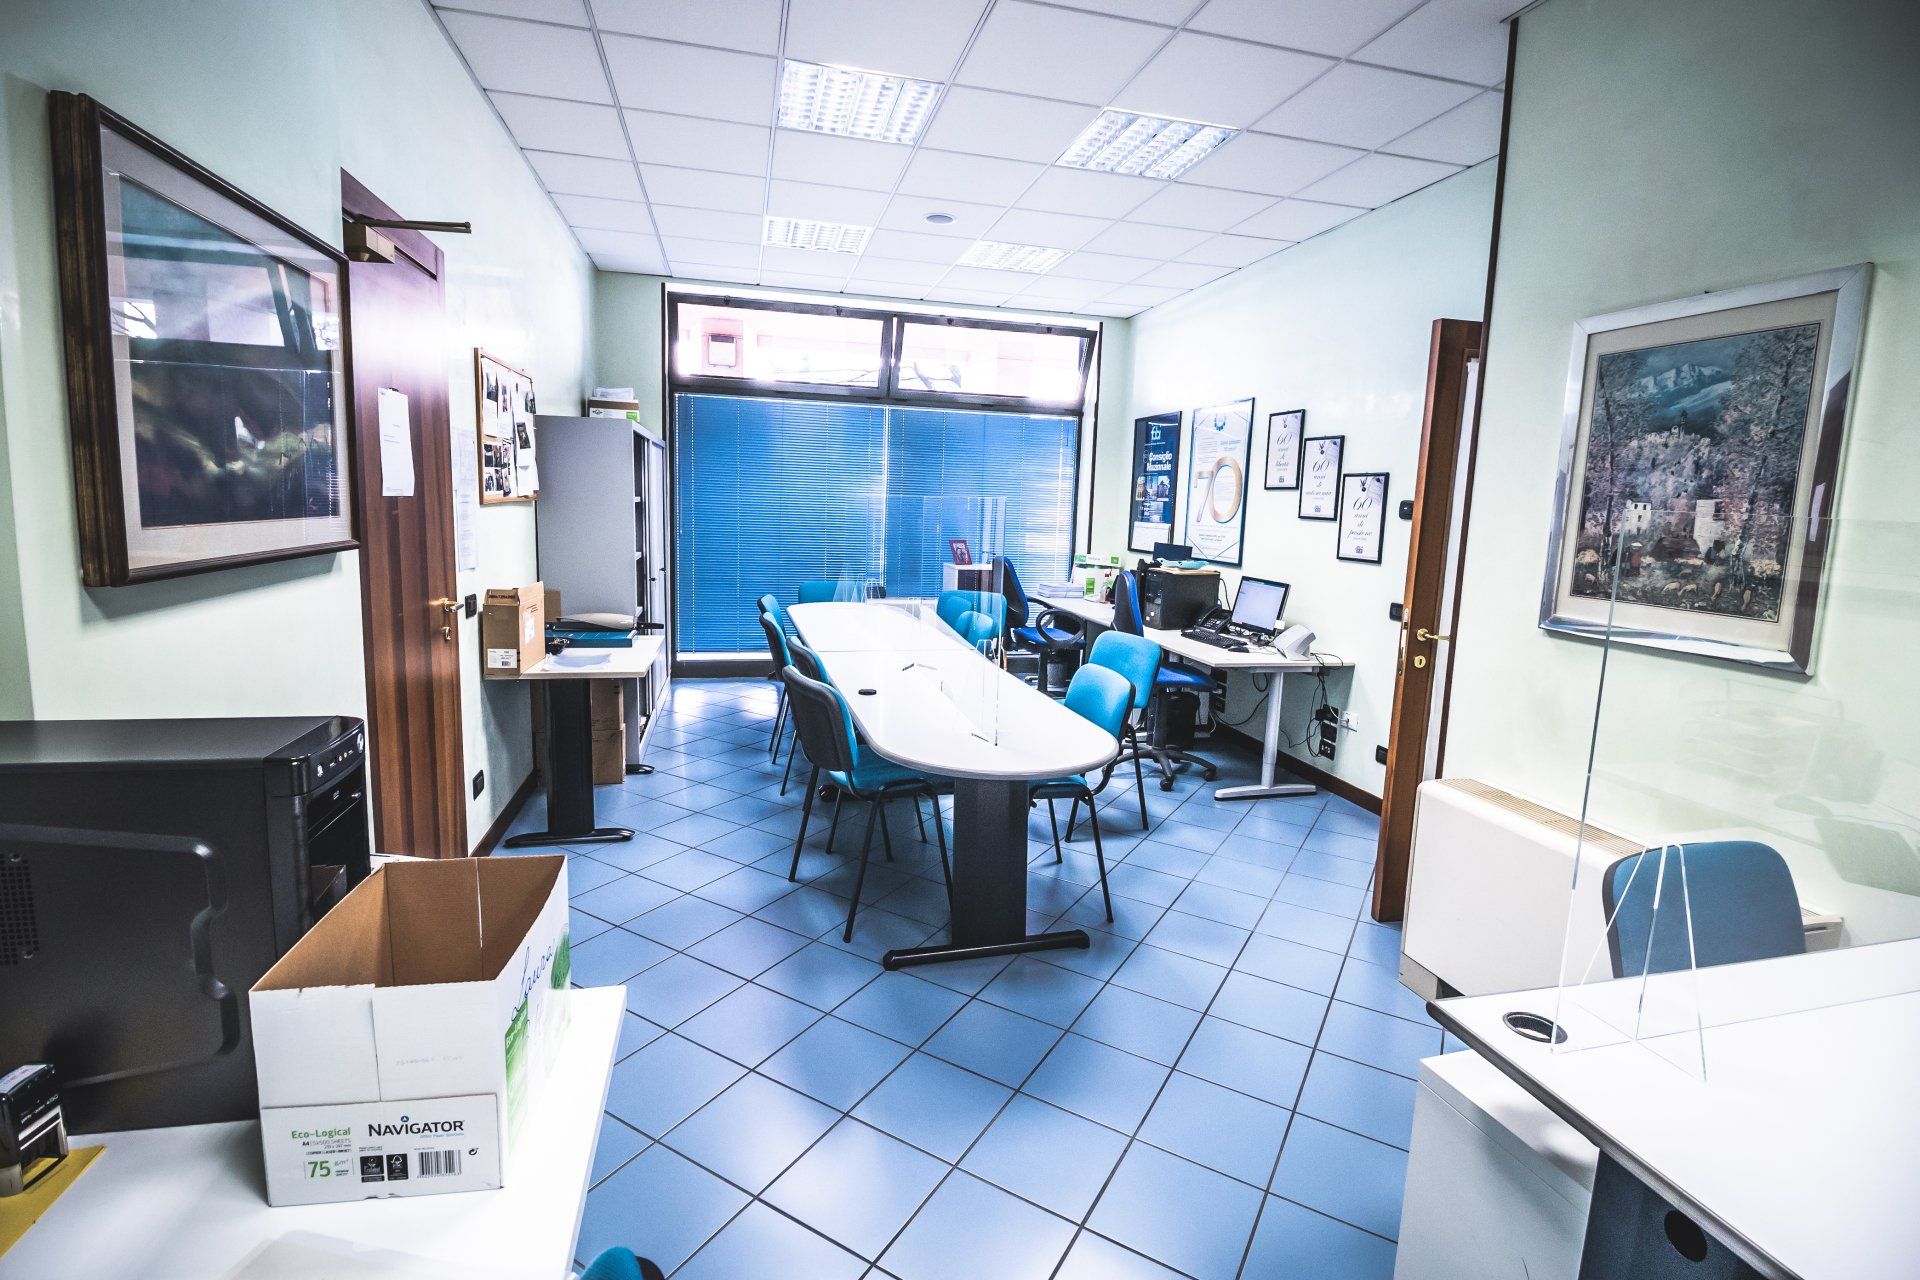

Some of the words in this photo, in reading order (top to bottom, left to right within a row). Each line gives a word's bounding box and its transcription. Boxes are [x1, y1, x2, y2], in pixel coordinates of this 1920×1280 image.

[1277, 432, 1293, 446] 60
[1313, 459, 1330, 472] 60
[1194, 456, 1243, 524] 70
[1353, 496, 1373, 511] 60
[291, 1127, 351, 1139] Eco-Logical
[368, 1120, 464, 1137] NAVIGATOR
[307, 1160, 331, 1178] 75
